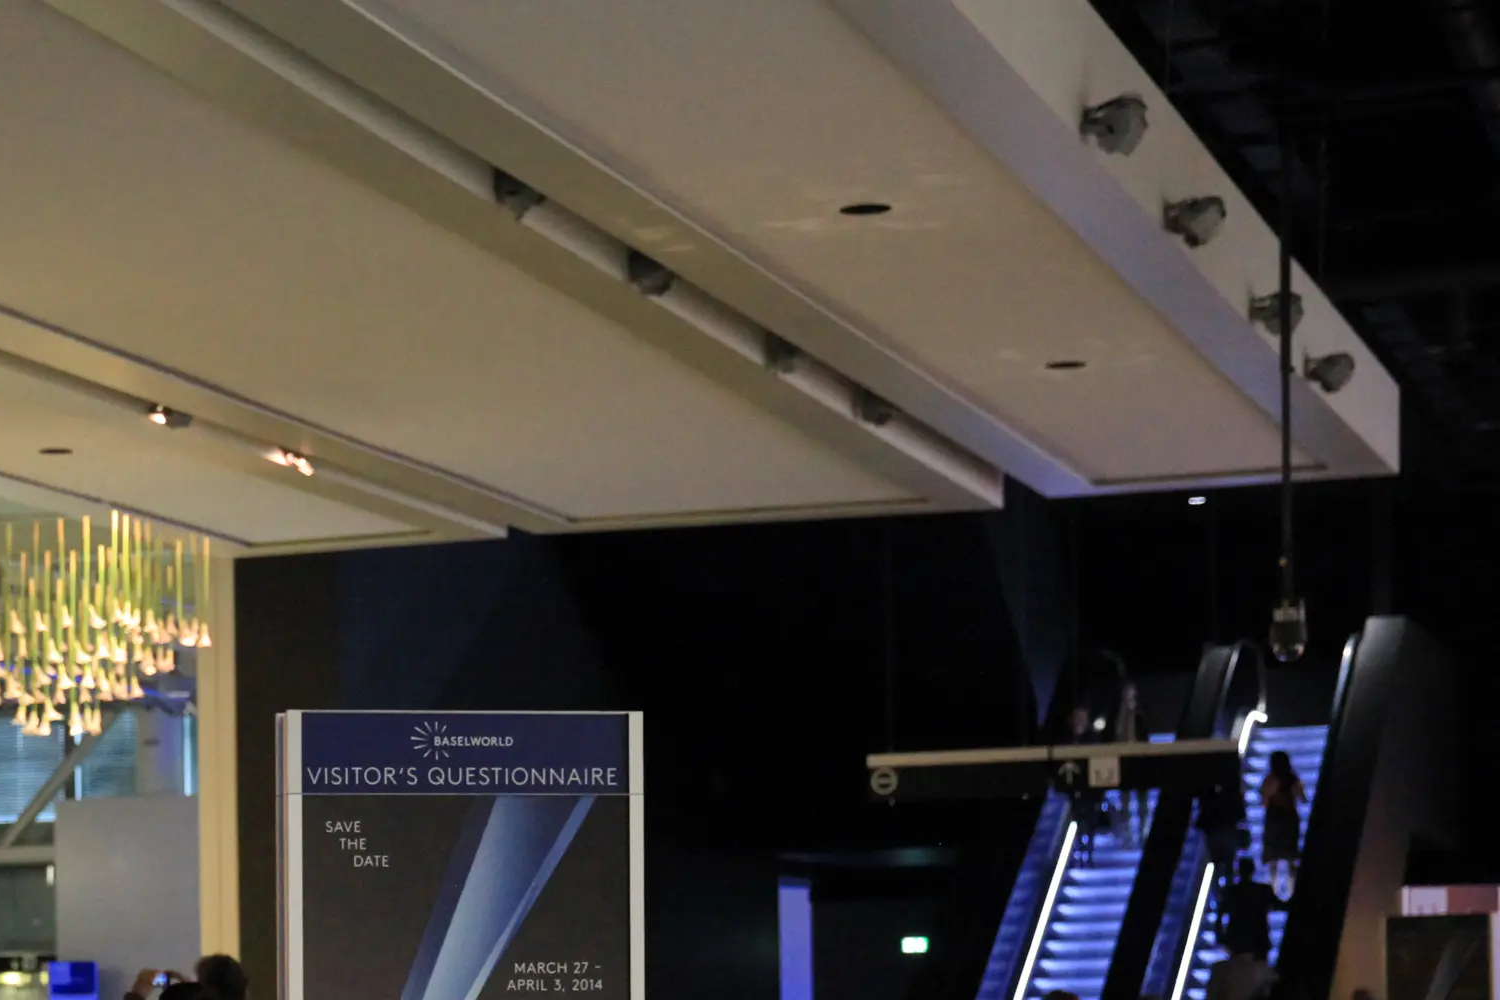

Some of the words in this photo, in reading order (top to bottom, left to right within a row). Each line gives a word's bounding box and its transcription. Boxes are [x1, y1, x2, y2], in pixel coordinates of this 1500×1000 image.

[433, 735, 514, 747] BASELWORLD
[306, 766, 419, 786] VISITOR'S
[427, 766, 619, 787] QUESTIONNAIRE
[325, 820, 362, 834] SAVE
[339, 837, 367, 851] THE
[353, 855, 390, 868] DATE
[514, 961, 568, 975] MARCH
[572, 961, 590, 974] 27
[506, 979, 548, 992] APRIL
[552, 979, 566, 993] 3,
[571, 979, 604, 992] 2014
